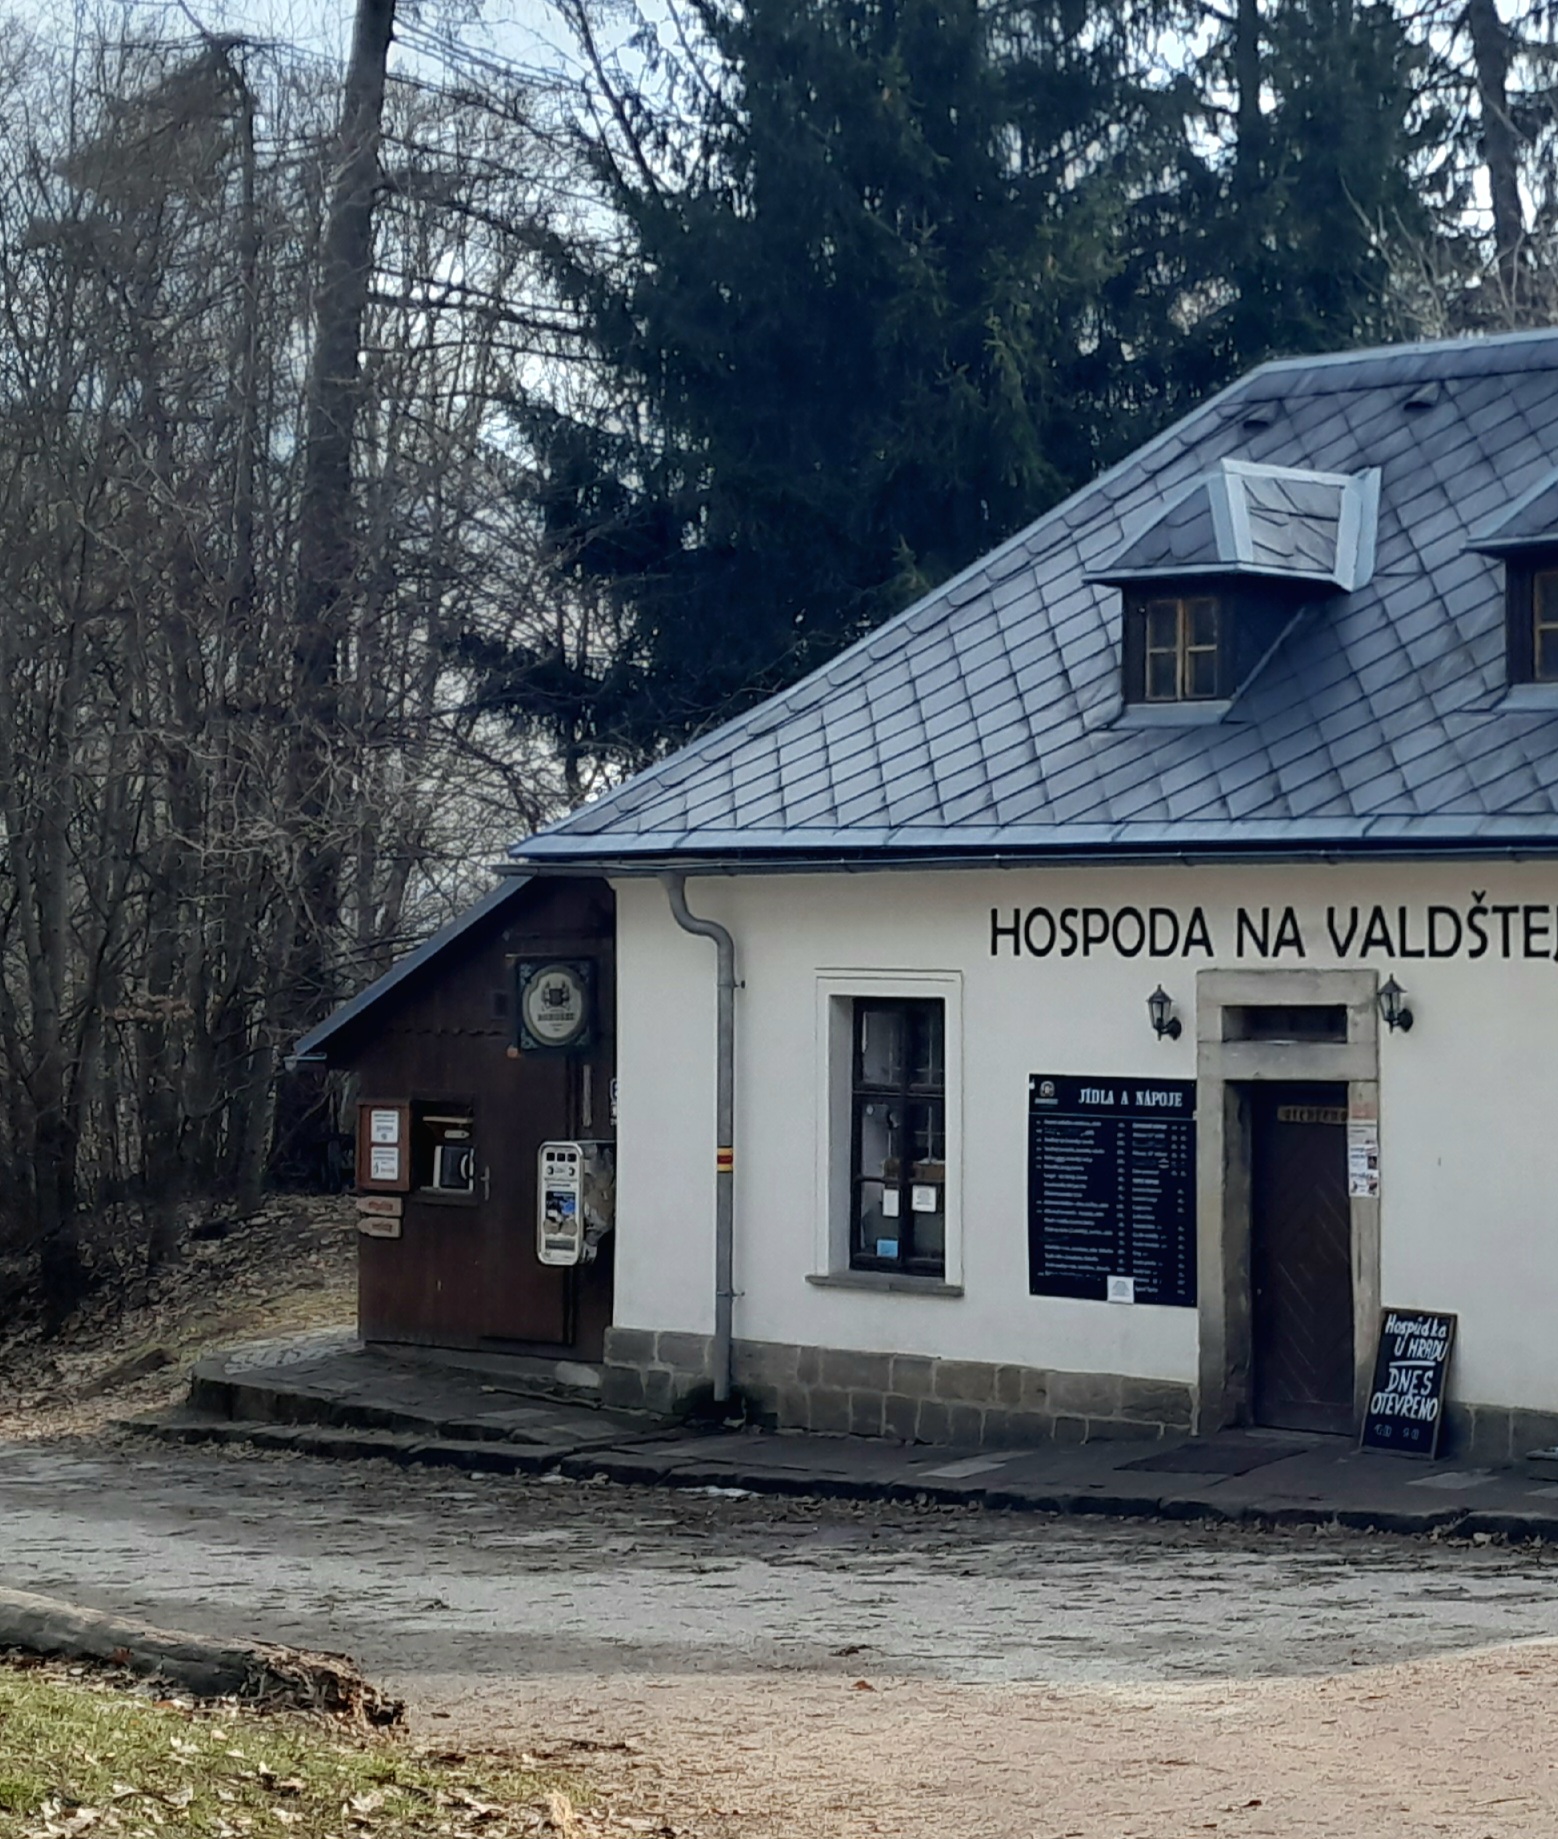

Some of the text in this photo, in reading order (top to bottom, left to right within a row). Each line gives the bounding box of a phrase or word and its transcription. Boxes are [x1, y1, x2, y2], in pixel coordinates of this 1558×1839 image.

[989, 906, 1214, 958] HOSPODA
[1235, 907, 1306, 958] NA
[1078, 1087, 1183, 1107] JÍDLA A NÁPOJE
[1394, 1336, 1449, 1362] U HRADU
[1384, 1368, 1434, 1396] DNES
